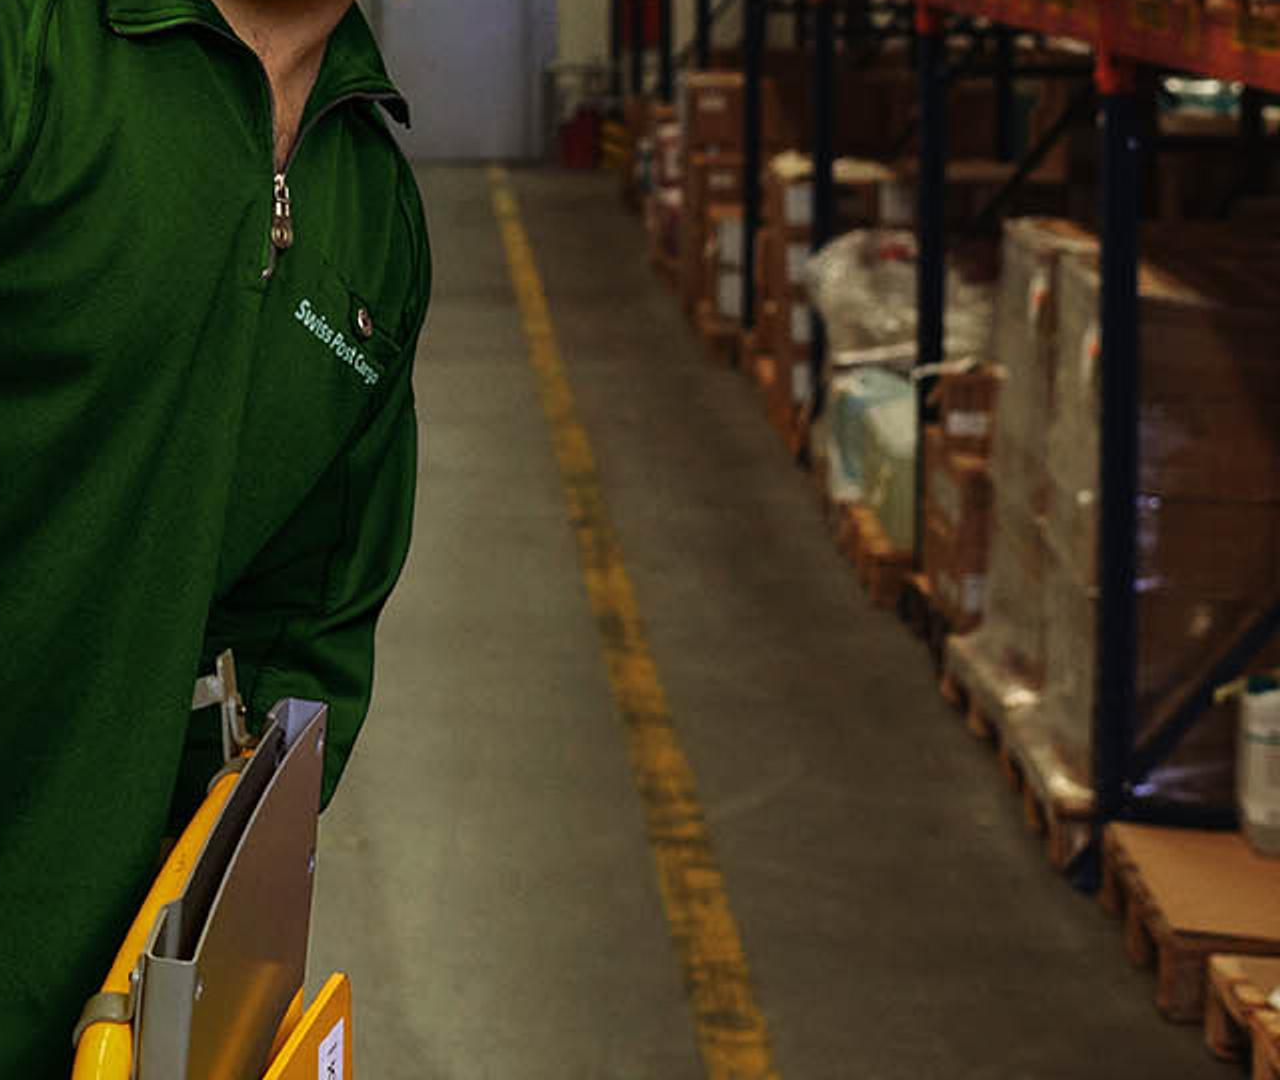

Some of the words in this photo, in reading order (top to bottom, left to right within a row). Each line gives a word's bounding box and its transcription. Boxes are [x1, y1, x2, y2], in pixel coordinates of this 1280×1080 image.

[293, 298, 335, 344] Swiss
[328, 331, 358, 365] Post
[353, 353, 380, 385] Cargo
